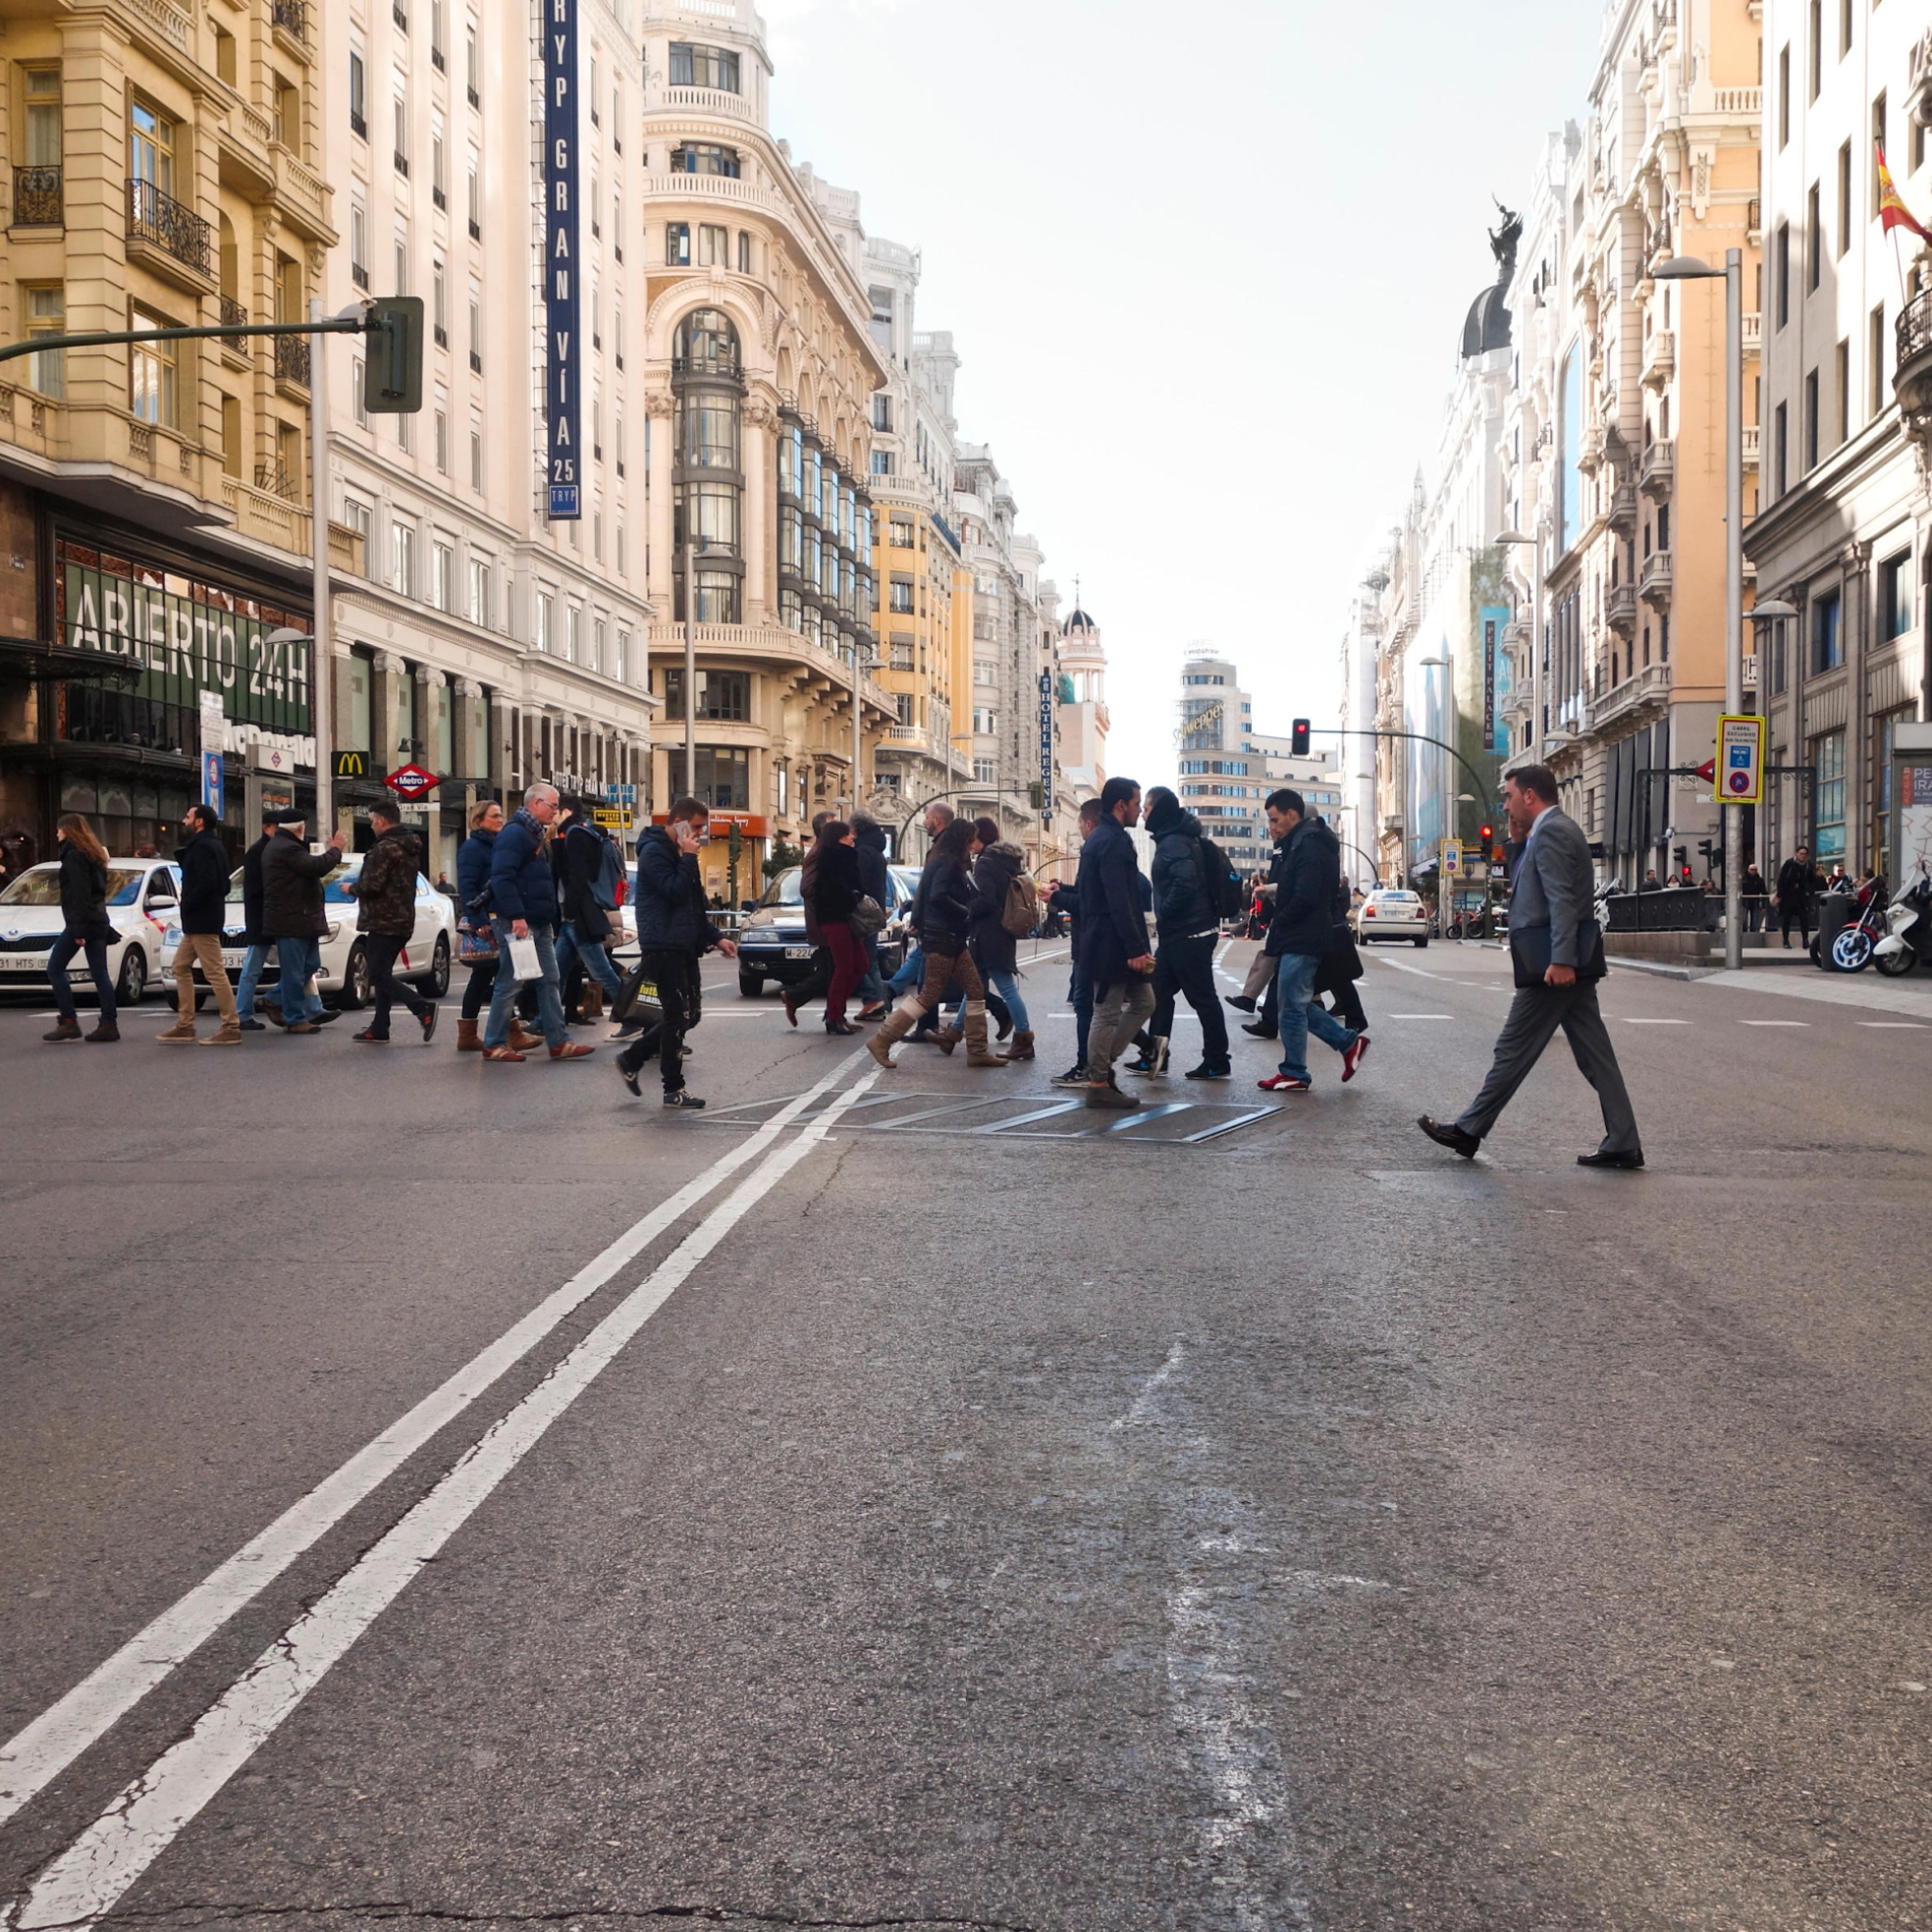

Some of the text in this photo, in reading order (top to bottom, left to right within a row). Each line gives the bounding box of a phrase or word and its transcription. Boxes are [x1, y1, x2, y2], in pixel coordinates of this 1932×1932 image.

[556, 138, 568, 299] GRAN
[557, 332, 570, 446] VÍA
[552, 490, 575, 502] TRYP
[555, 458, 573, 482] 25
[73, 583, 307, 706] ABIERTO 24H
[1041, 693, 1050, 818] HOTEL REGENTE
[16, 958, 34, 968] HTS
